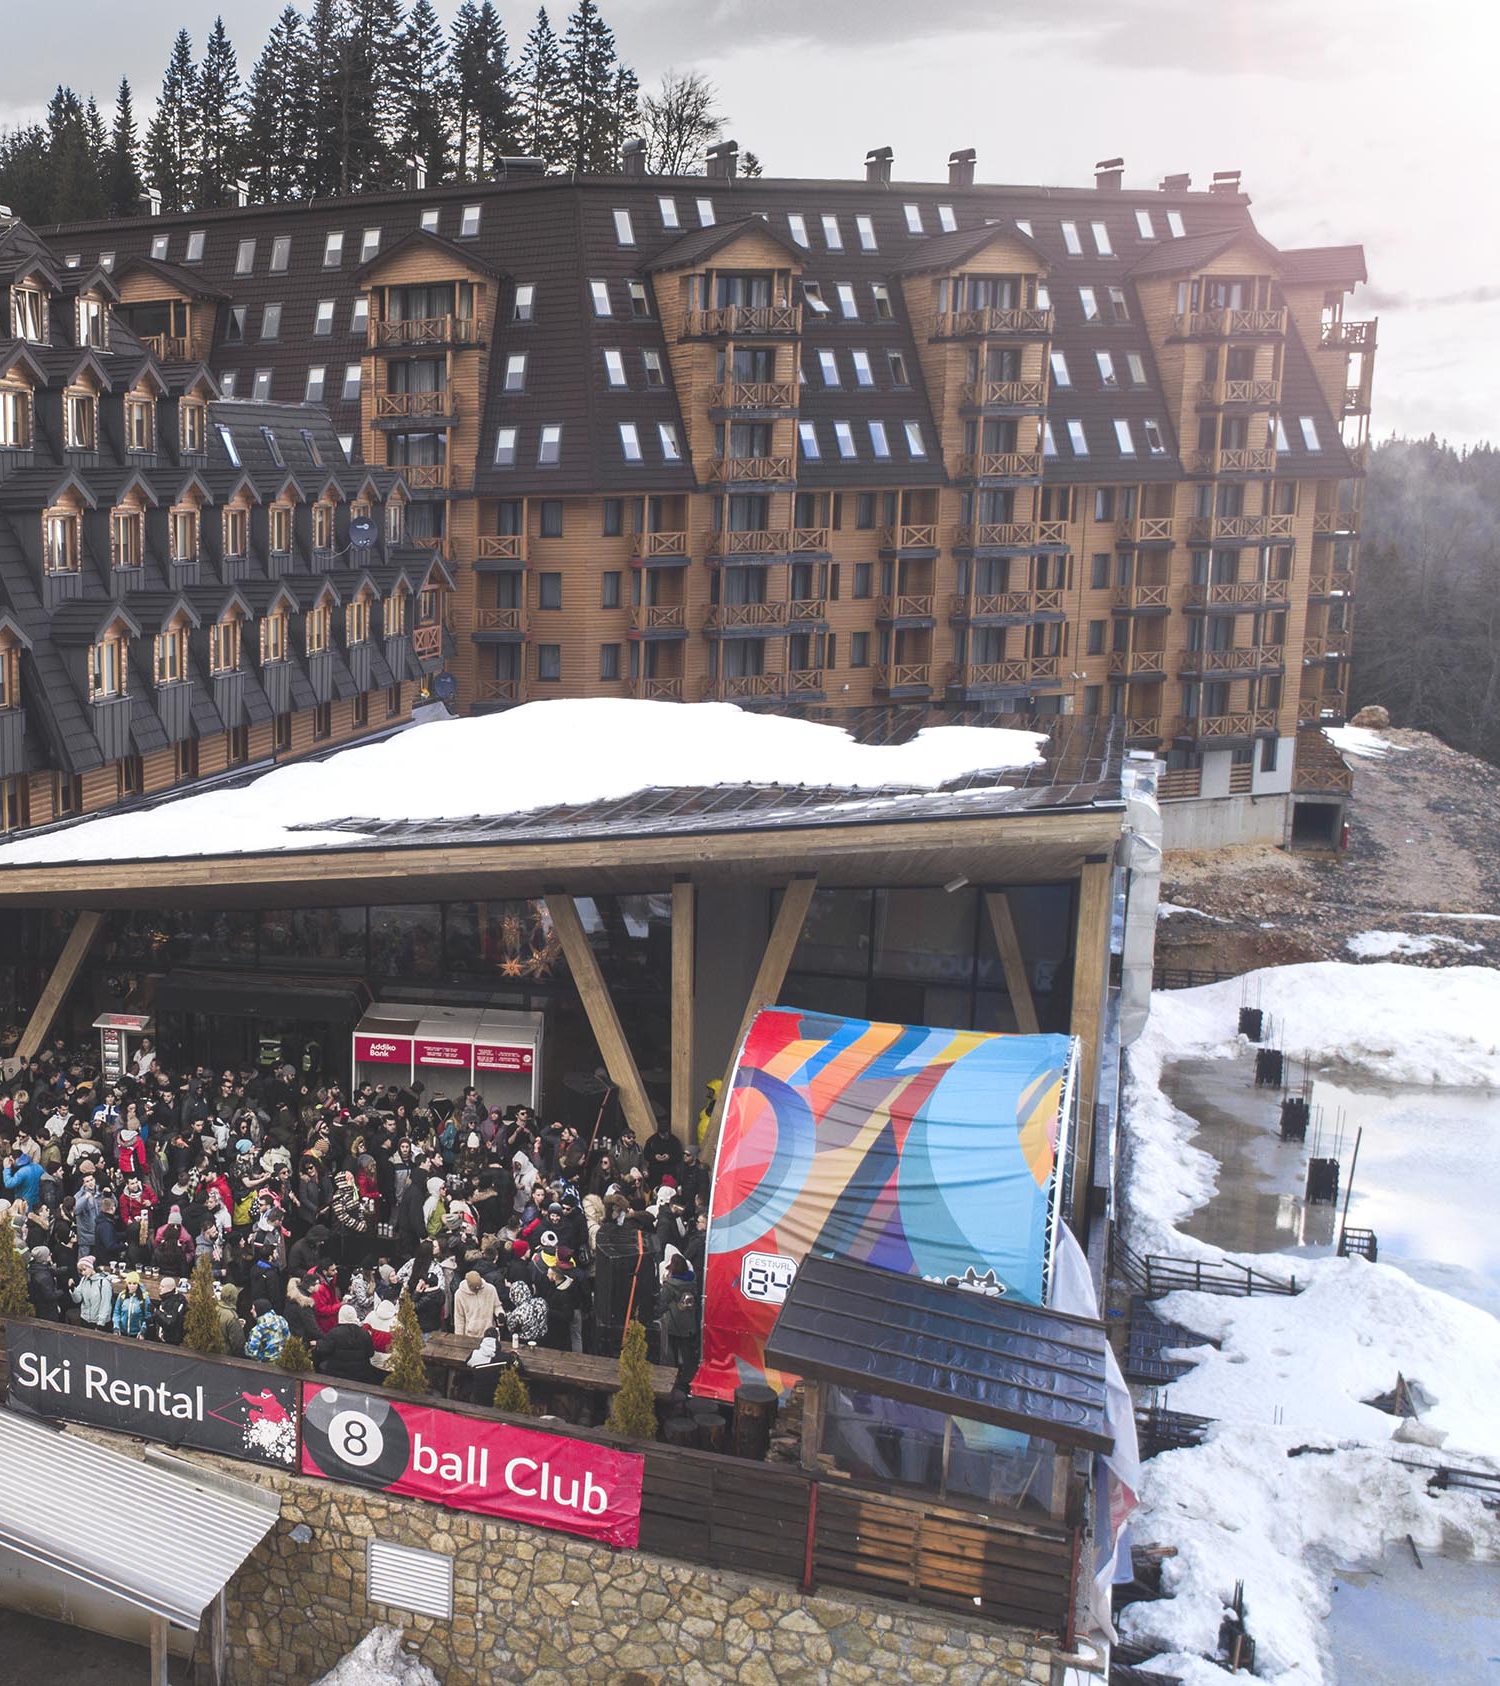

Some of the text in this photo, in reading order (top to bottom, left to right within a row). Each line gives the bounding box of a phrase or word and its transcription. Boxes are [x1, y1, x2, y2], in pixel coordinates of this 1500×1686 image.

[370, 1043, 396, 1052] Addiko
[749, 1257, 793, 1272] FESTIVAL
[18, 1352, 204, 1421] Ski Rental
[343, 1420, 608, 1515] 8 ball Club
